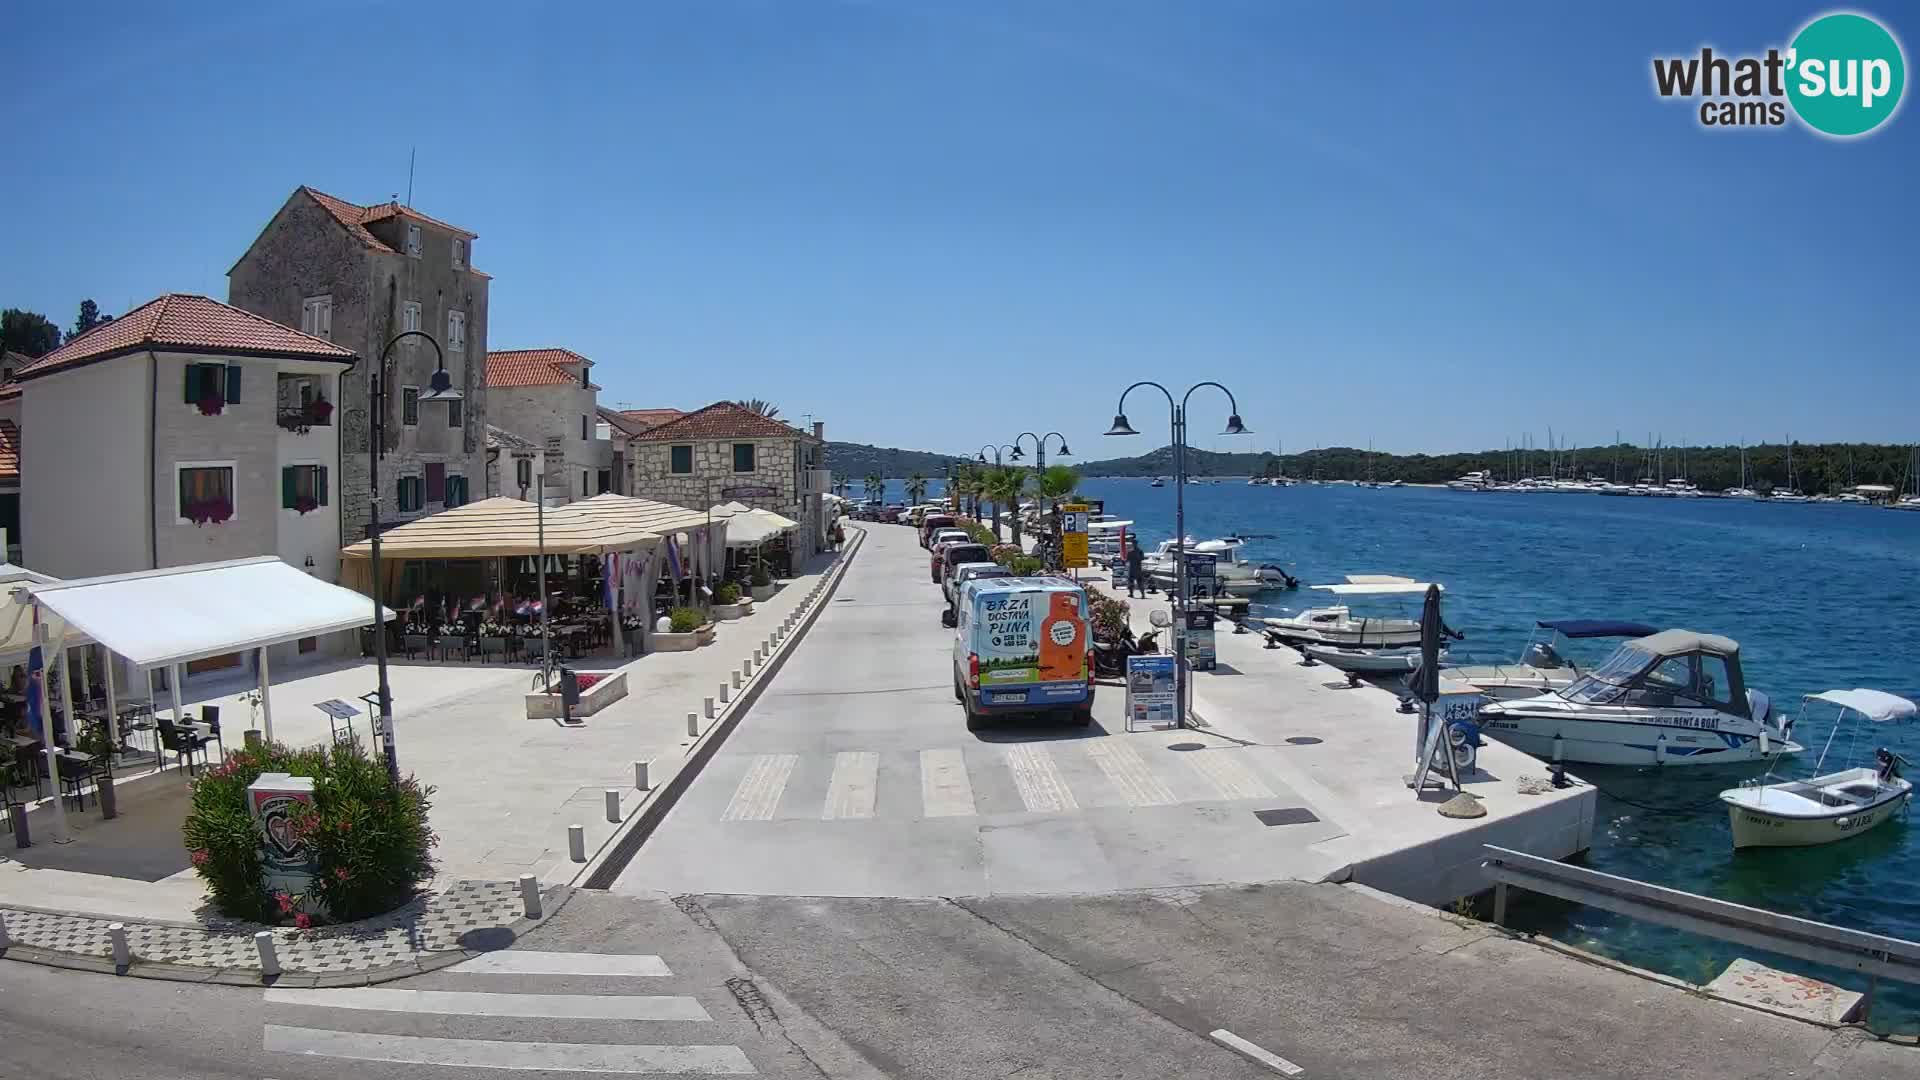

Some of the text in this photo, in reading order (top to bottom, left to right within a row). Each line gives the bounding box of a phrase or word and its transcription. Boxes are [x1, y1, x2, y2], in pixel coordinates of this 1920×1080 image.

[1065, 514, 1075, 530] P
[987, 599, 1029, 611] BRZA
[988, 611, 1029, 621] DOSTAVA
[990, 621, 1030, 634] PLINA
[1673, 717, 1694, 728] RENT
[1694, 718, 1699, 729] A
[1701, 718, 1720, 730] BOAT
